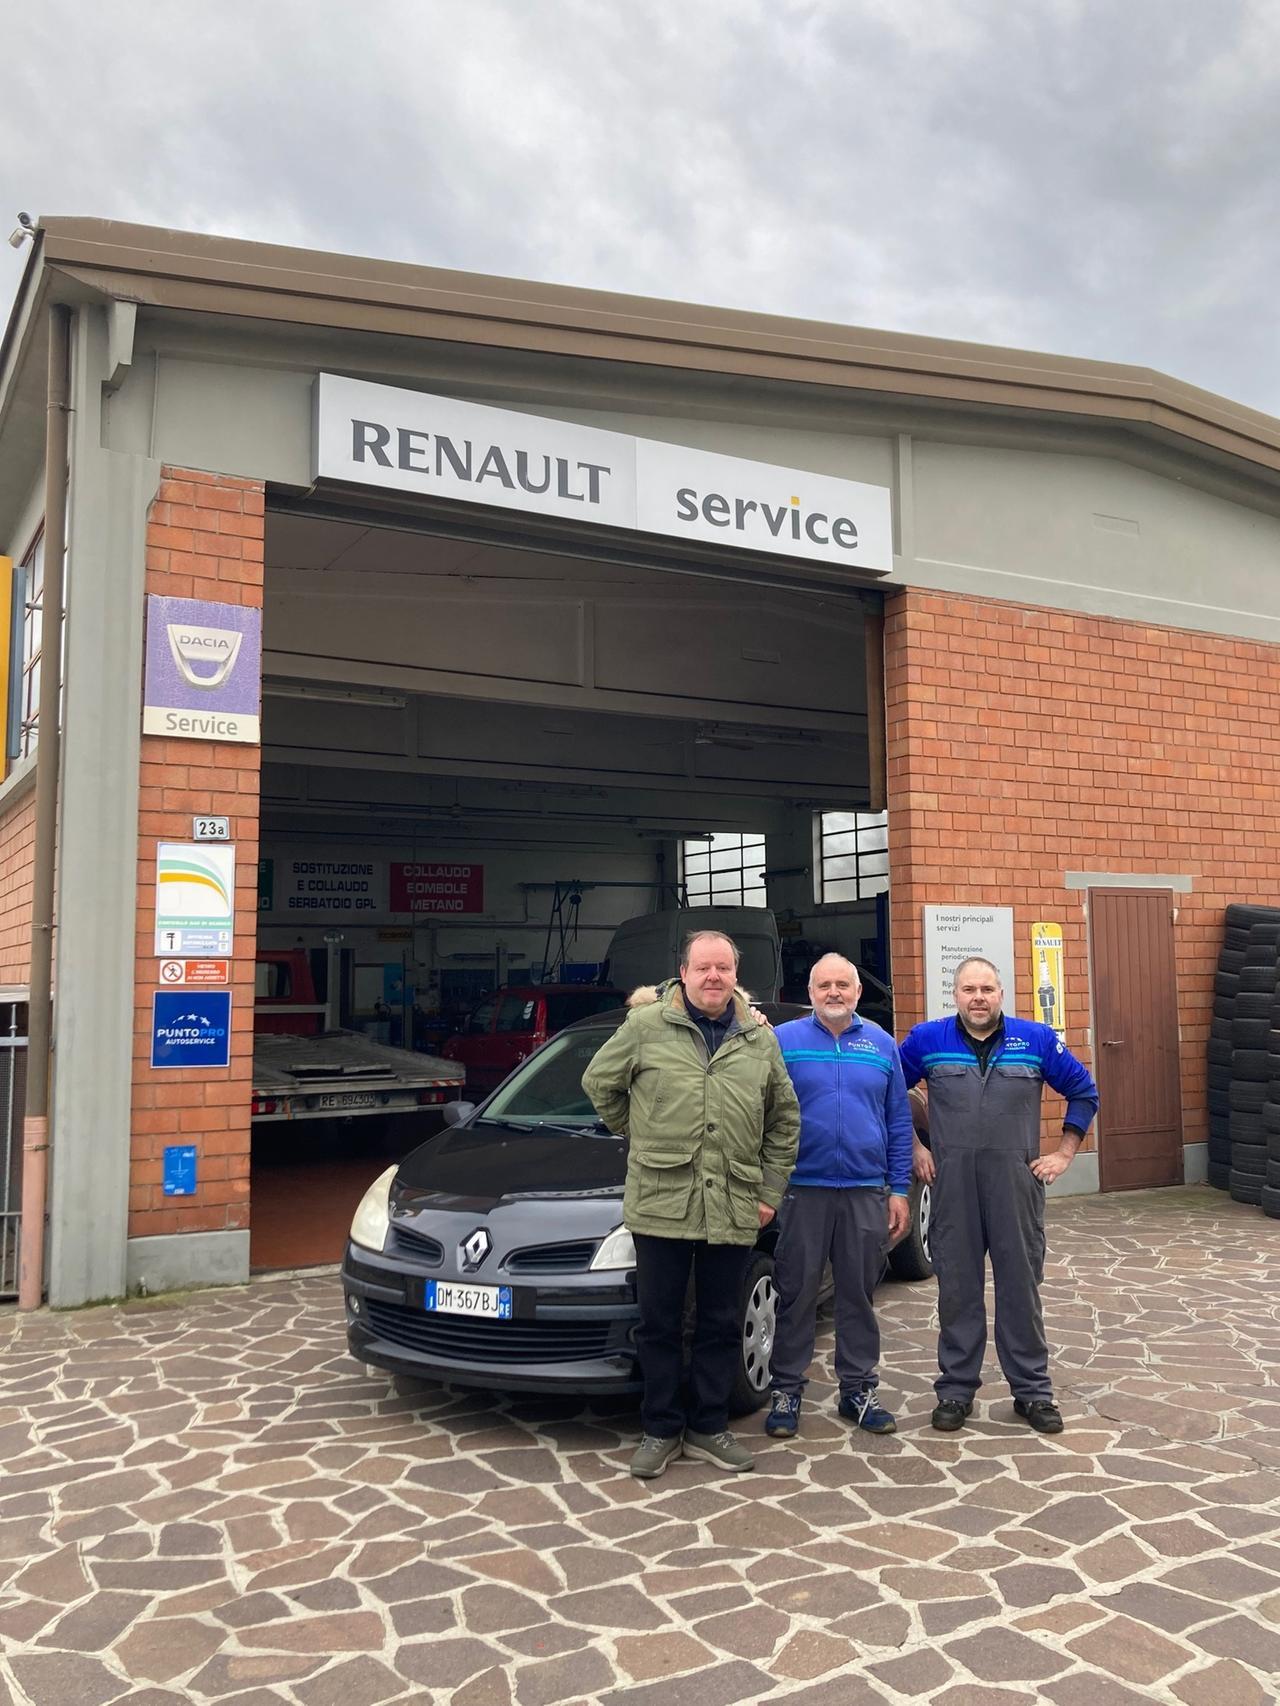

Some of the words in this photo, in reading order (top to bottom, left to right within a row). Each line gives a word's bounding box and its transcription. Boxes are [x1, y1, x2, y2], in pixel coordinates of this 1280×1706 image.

[350, 418, 611, 504] RENAULT
[676, 488, 858, 549] service
[180, 635, 229, 649] DACIA
[166, 712, 238, 735] Service
[199, 821, 224, 835] 23a
[293, 862, 373, 875] SOSTITUZIONE
[403, 865, 471, 878] COLLAUDO
[297, 880, 304, 891] E
[308, 880, 369, 892] COLLAUDO
[288, 897, 352, 909] SERBATOIO
[355, 898, 377, 910] GPL
[410, 898, 464, 911] METANO
[940, 914, 961, 922] nostri
[962, 914, 994, 924] principali
[936, 924, 961, 932] servizi
[941, 945, 984, 953] Manutenzione
